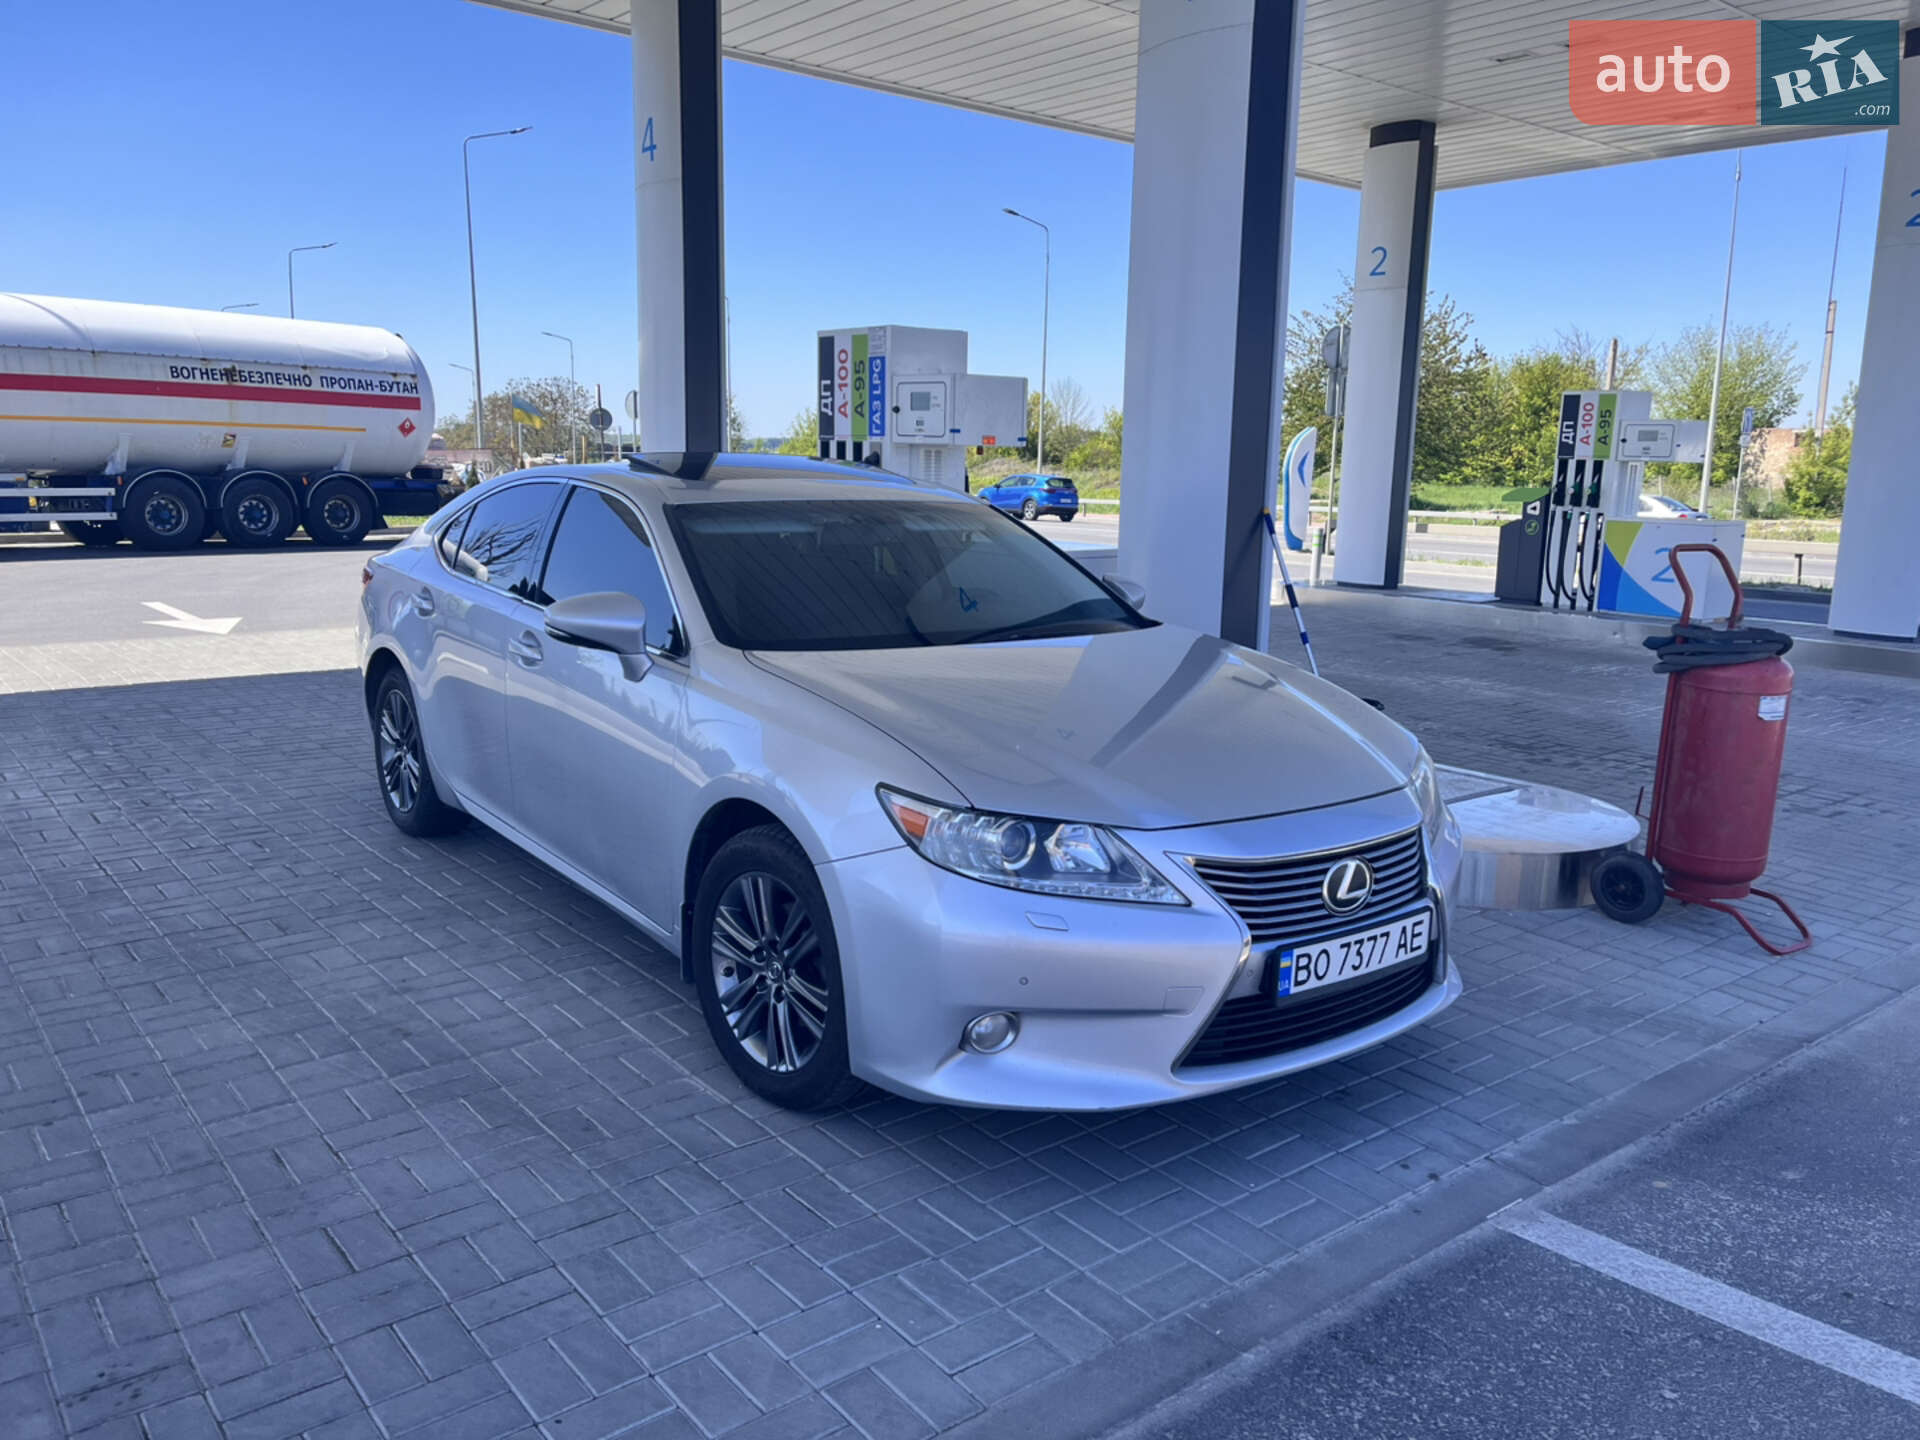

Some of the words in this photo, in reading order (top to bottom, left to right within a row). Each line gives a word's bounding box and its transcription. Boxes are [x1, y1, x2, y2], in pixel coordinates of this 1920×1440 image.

[642, 117, 657, 162] 4
[1369, 246, 1387, 276] 2
[169, 366, 313, 388] ВОГНЕНЕБЕЗПЕЧНО
[319, 375, 419, 395] ПРОПАН-БУТАН
[872, 358, 882, 395] LPG
[820, 379, 833, 416] ДП
[872, 399, 882, 434] ГАЗ
[1294, 948, 1331, 988] BO
[1337, 930, 1392, 976] 7377
[1395, 919, 1425, 959] AE
